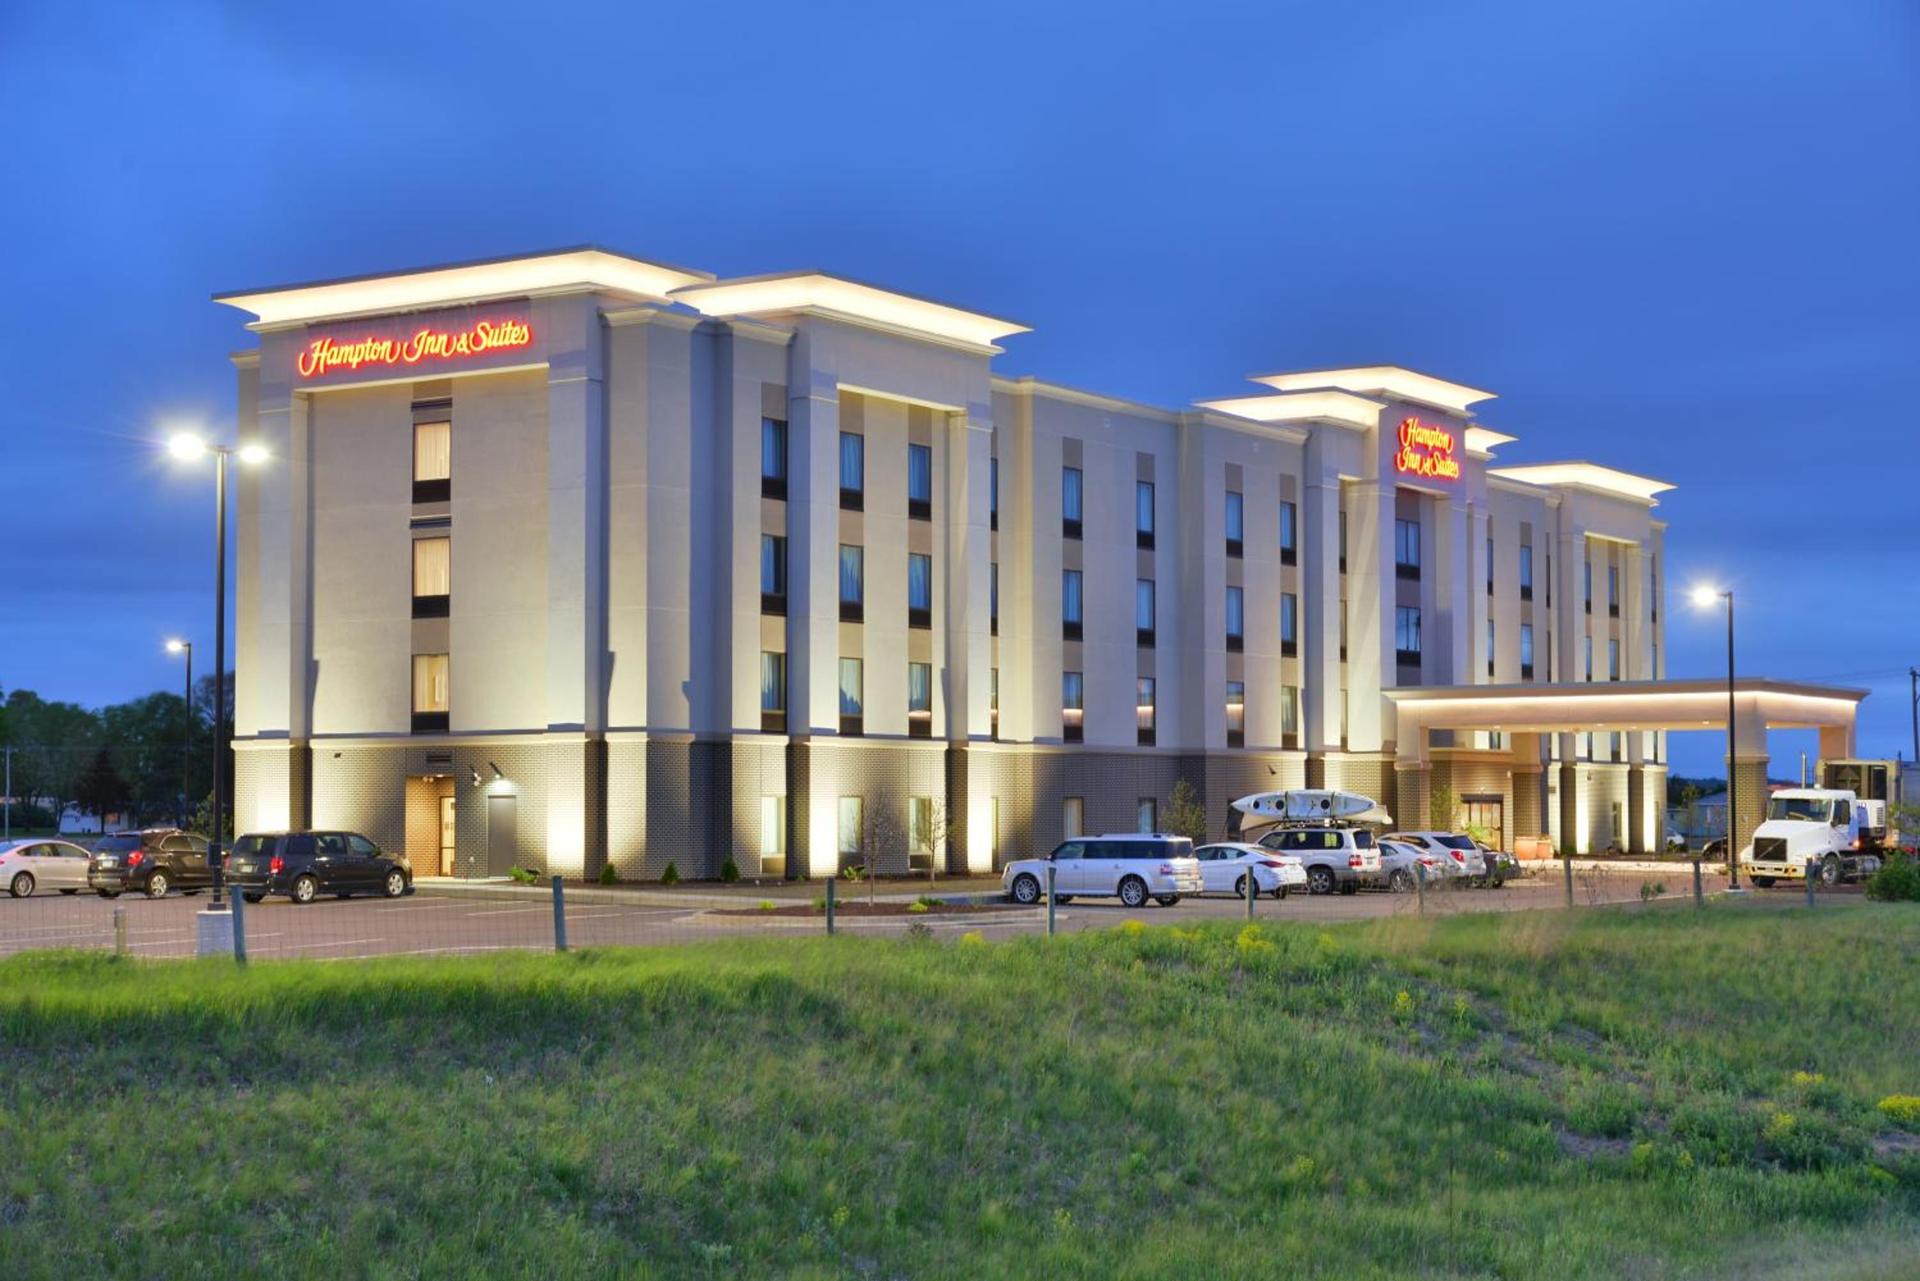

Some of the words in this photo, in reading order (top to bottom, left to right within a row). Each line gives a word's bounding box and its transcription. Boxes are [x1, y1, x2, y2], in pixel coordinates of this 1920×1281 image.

[298, 337, 400, 376] Hampton
[402, 329, 457, 362] Inn
[457, 332, 471, 353] &
[469, 320, 529, 350] Suites
[1400, 417, 1453, 453] Hampton
[1397, 446, 1425, 475] Inn
[1431, 451, 1459, 478] Suites
